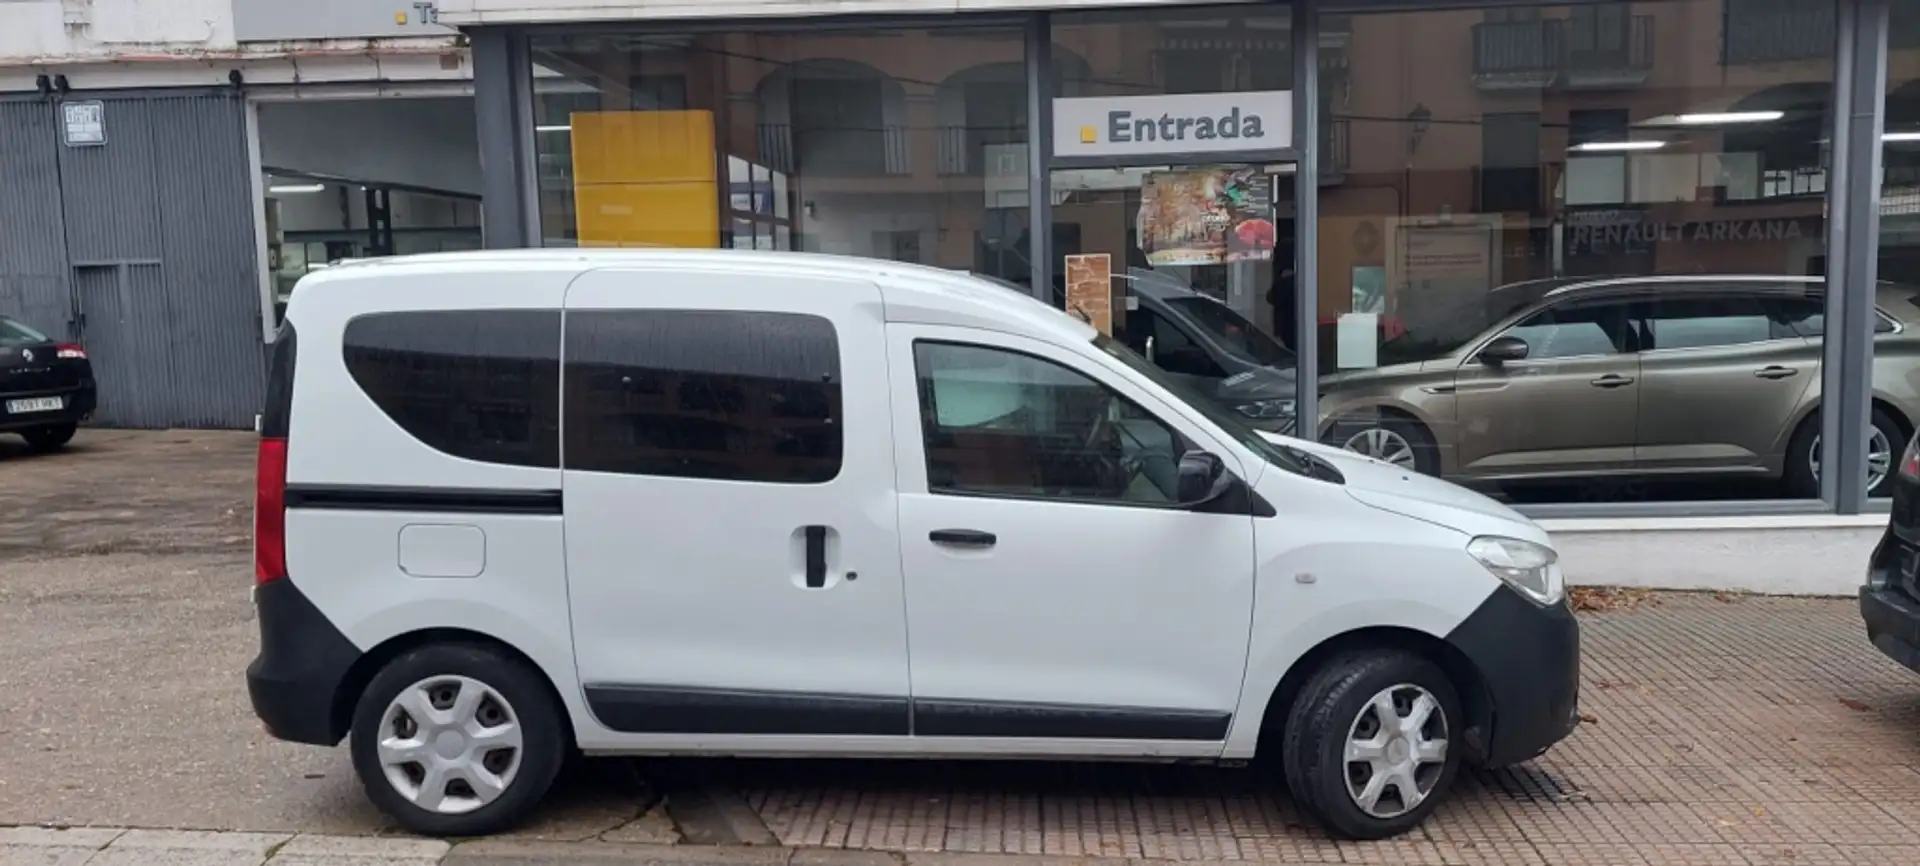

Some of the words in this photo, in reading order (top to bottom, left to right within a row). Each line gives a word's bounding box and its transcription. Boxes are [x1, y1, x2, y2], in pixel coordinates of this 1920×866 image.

[1108, 107, 1264, 142] Entrada
[1574, 223, 1690, 245] RENAULT
[1693, 220, 1804, 242] ARKANA
